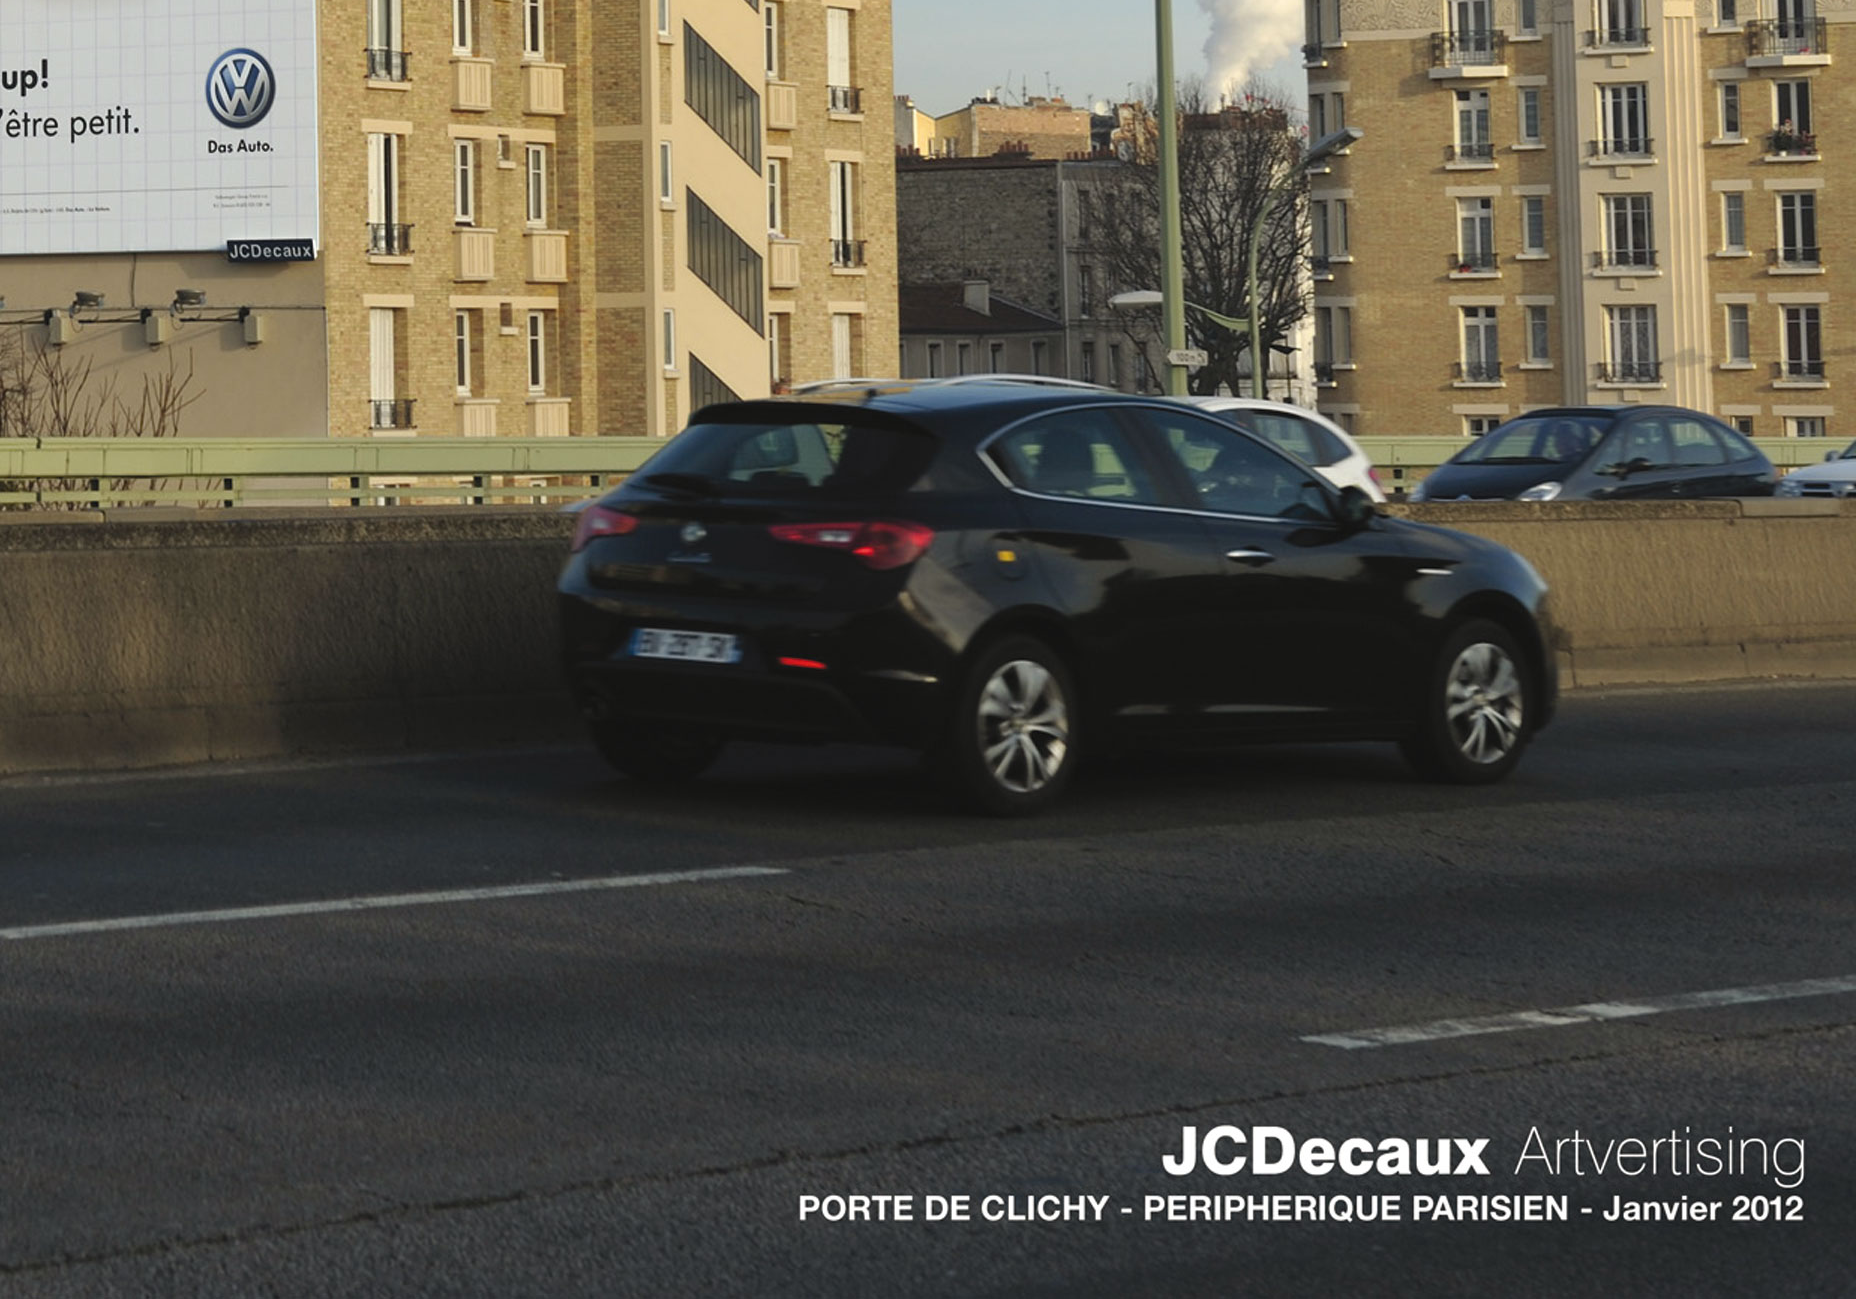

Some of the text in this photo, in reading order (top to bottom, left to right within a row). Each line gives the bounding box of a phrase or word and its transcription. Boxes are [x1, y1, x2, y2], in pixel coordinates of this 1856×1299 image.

[1, 58, 49, 98] up!
[70, 105, 140, 144] petit.
[207, 138, 274, 154] Das Auto.
[230, 243, 312, 259] JCDecaux
